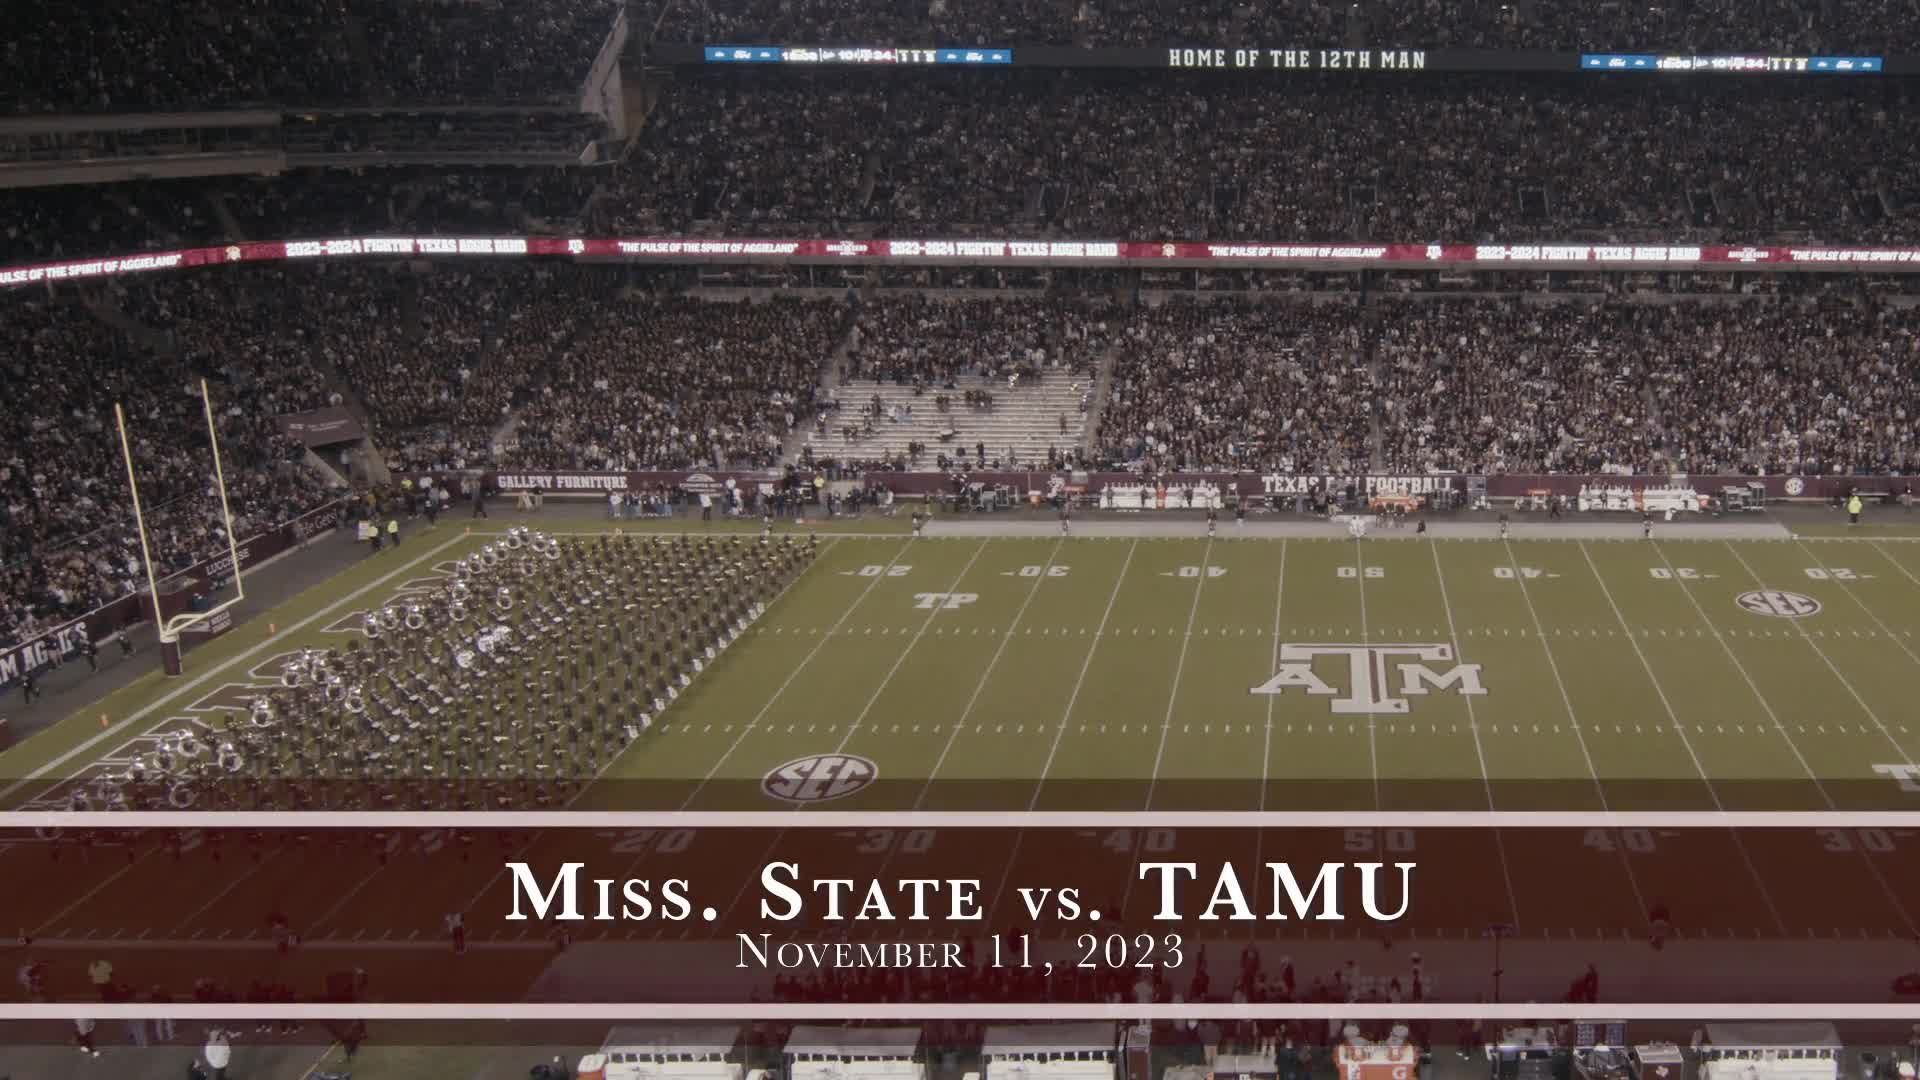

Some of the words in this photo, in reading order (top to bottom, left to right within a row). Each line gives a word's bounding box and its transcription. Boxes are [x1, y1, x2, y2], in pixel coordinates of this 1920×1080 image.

[1168, 49, 1225, 66] HOME
[1235, 50, 1259, 66] OF
[1270, 50, 1310, 67] THE
[1320, 50, 1370, 68] 12TH
[1380, 51, 1425, 68] MAN
[286, 240, 362, 257] 2023-2024
[416, 239, 457, 253] TEXAS
[459, 239, 494, 253] AGGIE
[494, 240, 527, 253] BAND
[640, 242, 669, 253] PULSE
[669, 242, 684, 253] OF
[684, 243, 701, 253] THE
[701, 243, 730, 253] SPIRIT
[730, 243, 743, 253] OF
[890, 241, 955, 256] 2023-2024
[1009, 242, 1048, 256] TEXAS
[1051, 243, 1084, 256] AGGIE
[1086, 243, 1118, 256] BAND
[1230, 246, 1258, 257] PULSE
[1258, 246, 1273, 257] OF
[1272, 247, 1290, 257] THE
[1290, 247, 1319, 257] SPIRIT
[1318, 247, 1333, 257] OF
[1476, 246, 1540, 260] 2023-2024
[1593, 247, 1632, 260] TEXAS
[1811, 250, 1840, 260] PULSE
[1839, 250, 1853, 260] OF
[1852, 250, 1871, 260] THE
[1870, 250, 1899, 260] SPIRIT
[1898, 251, 1912, 260] OF
[29, 268, 45, 281] OF
[45, 266, 67, 278] THE
[68, 263, 103, 275] SPIRIT
[103, 261, 119, 273] OF
[498, 476, 553, 489] GALLERY
[556, 476, 628, 489] FURNITURE
[1261, 475, 1320, 493] TEXAS
[1365, 476, 1453, 493] FOOTBALL
[205, 548, 250, 576] LUCCHSE
[913, 593, 979, 608] TP
[1737, 590, 1821, 617] SEC
[762, 754, 878, 801] SEC
[612, 830, 696, 853] 20
[858, 829, 937, 853] 30
[1102, 829, 1176, 852] 40
[1344, 829, 1416, 852] 50
[1584, 829, 1656, 852] 40
[1816, 828, 1896, 852] 30
